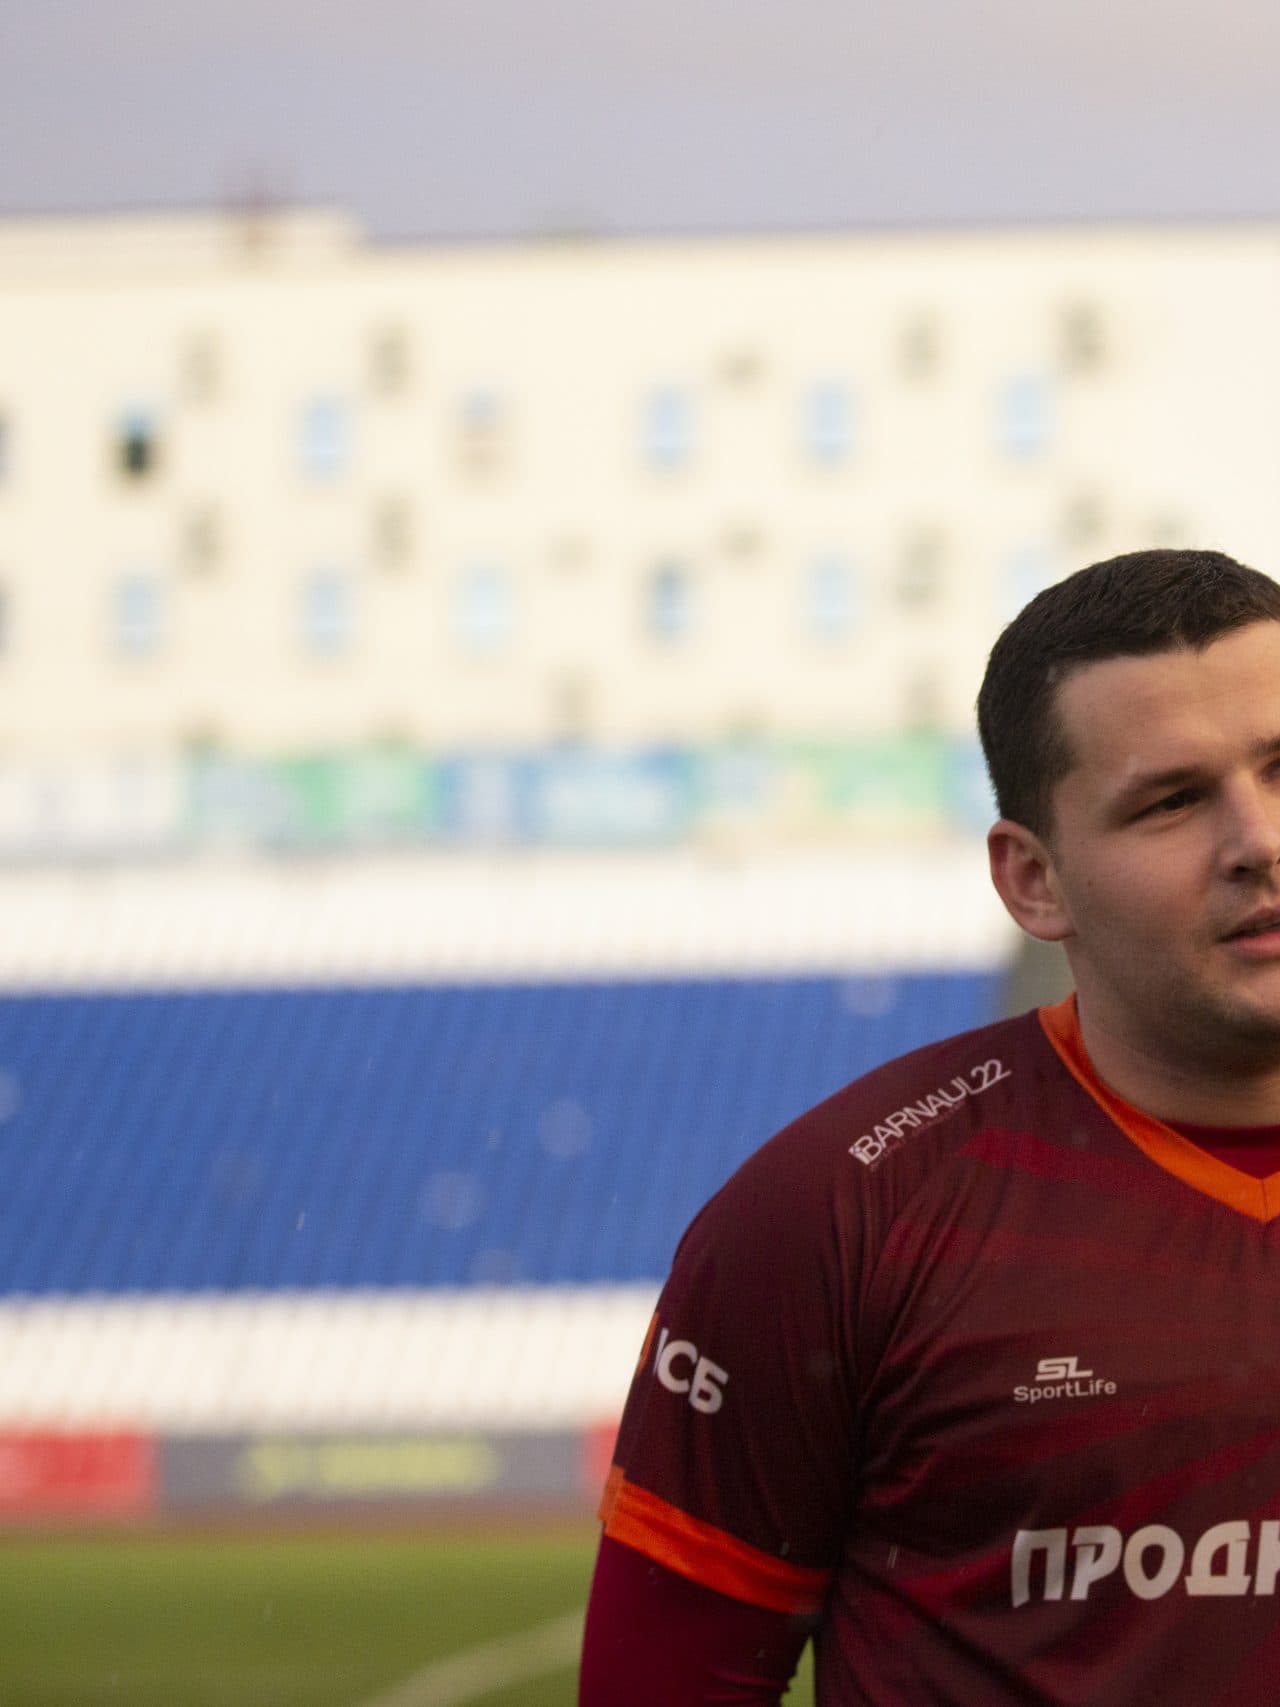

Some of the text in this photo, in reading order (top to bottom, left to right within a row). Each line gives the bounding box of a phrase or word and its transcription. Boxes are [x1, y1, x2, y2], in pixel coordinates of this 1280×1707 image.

[850, 1059, 1012, 1165] BARNAUL22
[1036, 1356, 1093, 1381] SL
[1014, 1379, 1117, 1404] SportLife
